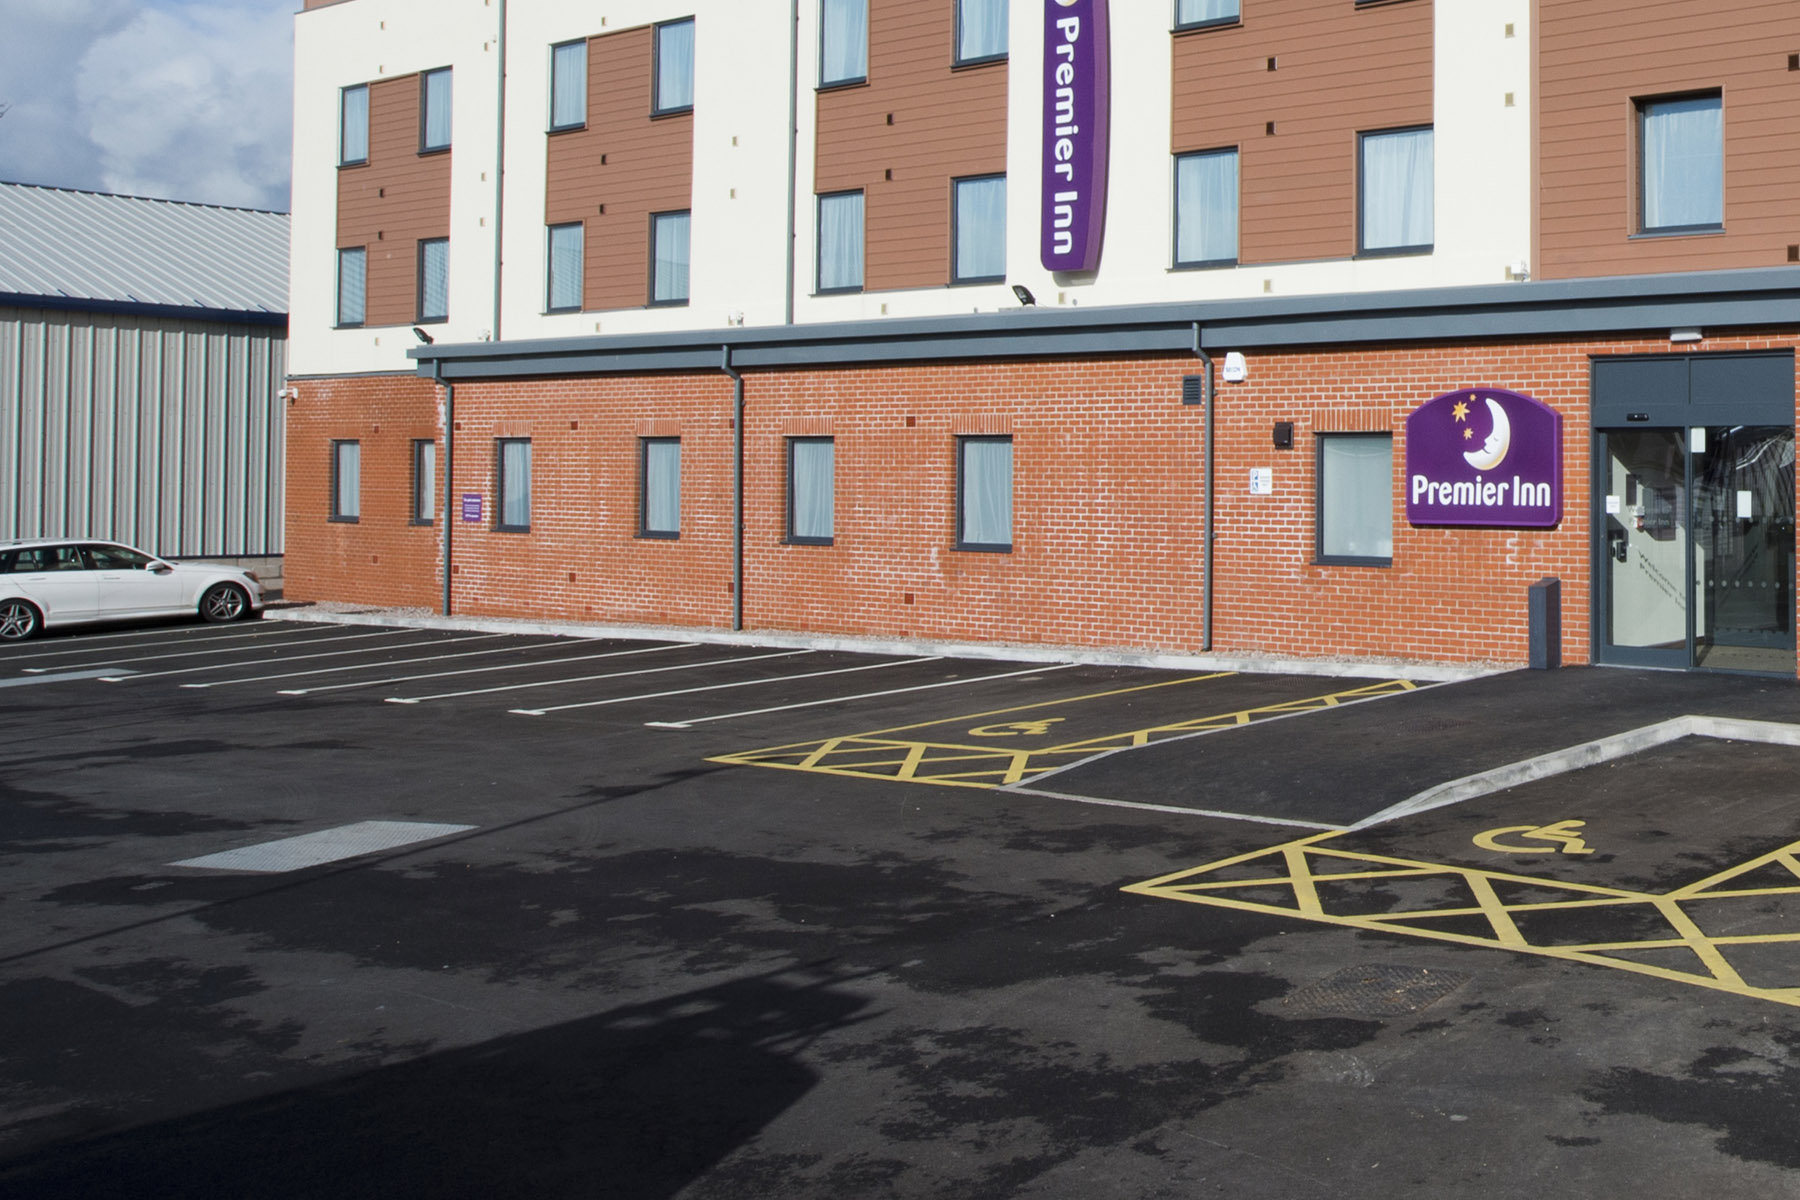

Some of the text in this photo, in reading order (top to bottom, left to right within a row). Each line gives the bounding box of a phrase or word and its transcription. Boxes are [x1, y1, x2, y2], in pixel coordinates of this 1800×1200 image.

[1053, 16, 1080, 254] Premier Inn
[1412, 475, 1551, 507] Premier Inn
